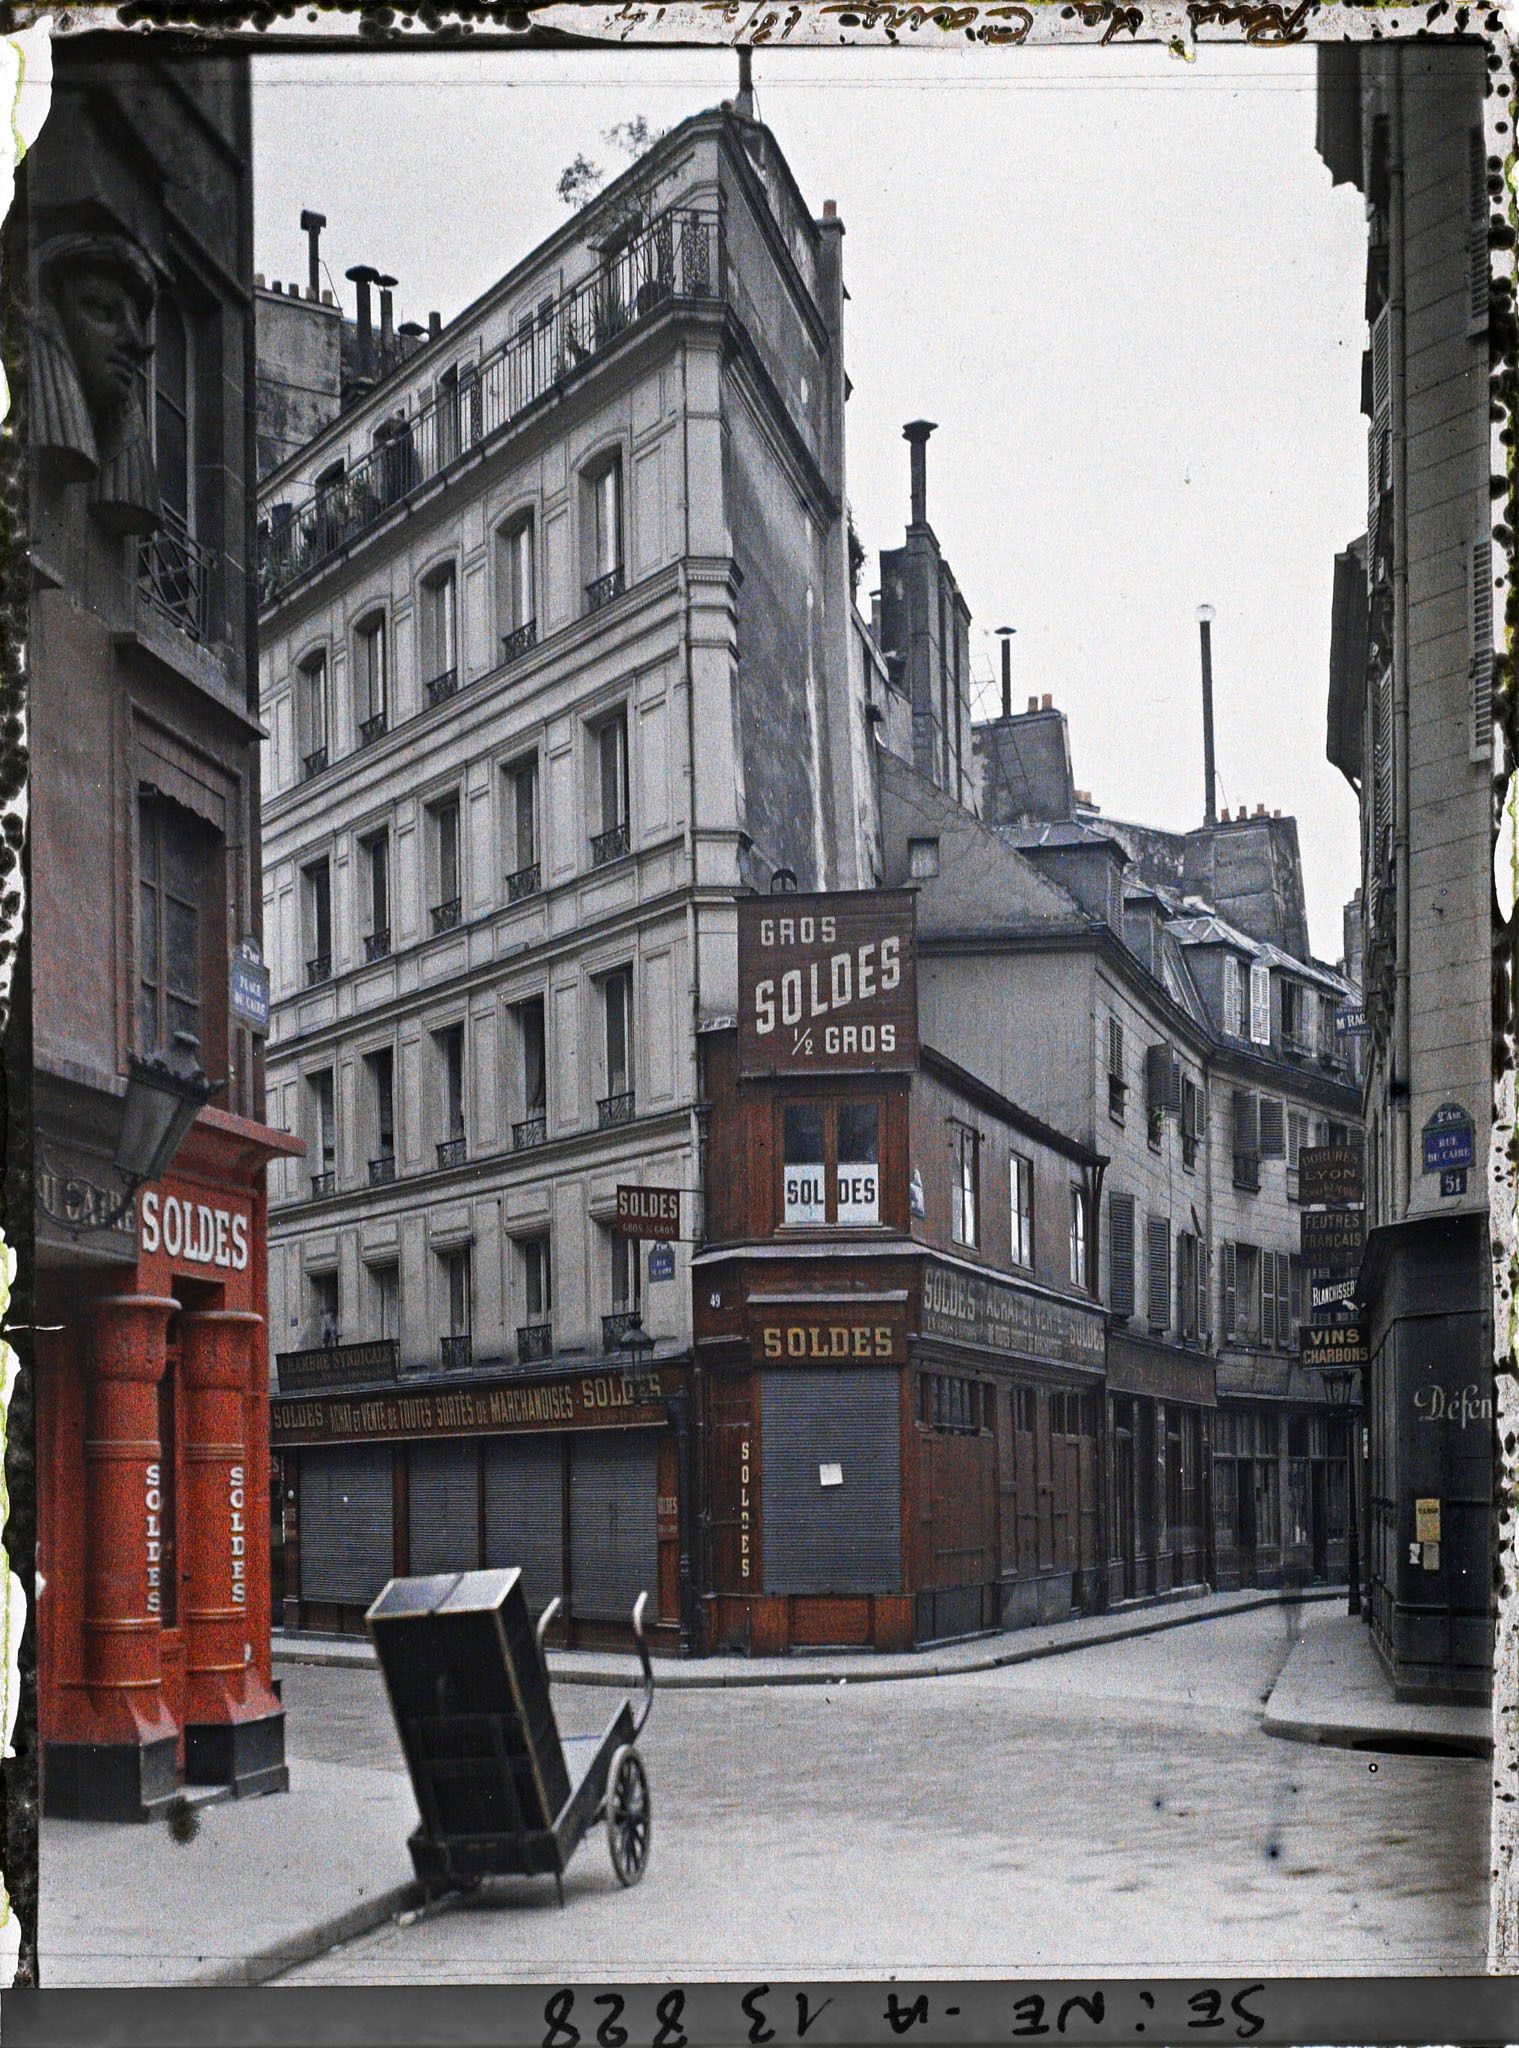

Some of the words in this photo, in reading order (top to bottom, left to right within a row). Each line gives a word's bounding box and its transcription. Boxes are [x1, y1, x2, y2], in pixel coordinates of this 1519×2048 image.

[761, 916, 836, 946] GROS
[755, 936, 900, 1035] SOLDES
[825, 1024, 896, 1054] GROS
[1427, 1152, 1440, 1162] DU
[1442, 1147, 1471, 1160] CAIRE
[1439, 1137, 1457, 1148] RUE
[1305, 1169, 1356, 1181] LYON
[1446, 1175, 1461, 1193] 51
[619, 1191, 678, 1219] SOLDES
[787, 1180, 824, 1205] SOL
[839, 1178, 875, 1204] DES
[142, 1192, 248, 1270] SOLDES
[622, 1223, 643, 1233] GROS
[654, 1225, 675, 1235] GROS
[1305, 1213, 1360, 1230] FEUTRES
[710, 1294, 721, 1308] 49
[924, 1268, 976, 1321] SOLDES
[763, 1327, 893, 1357] SOLDES
[1310, 1329, 1360, 1345] VINS
[1303, 1347, 1369, 1364] CHARBONS
[273, 1403, 323, 1429] SOLDES
[361, 1401, 386, 1433] VENTE
[387, 1407, 398, 1430] DE
[398, 1398, 432, 1430] TOUTES
[436, 1394, 474, 1427] SORTES
[475, 1400, 488, 1425] DE
[489, 1385, 574, 1425] MARCHANDISES
[741, 1442, 750, 1578] SOLDES
[145, 1464, 161, 1612] SOLDES
[230, 1466, 246, 1604] SOLDES
[542, 1988, 688, 2048] 828
